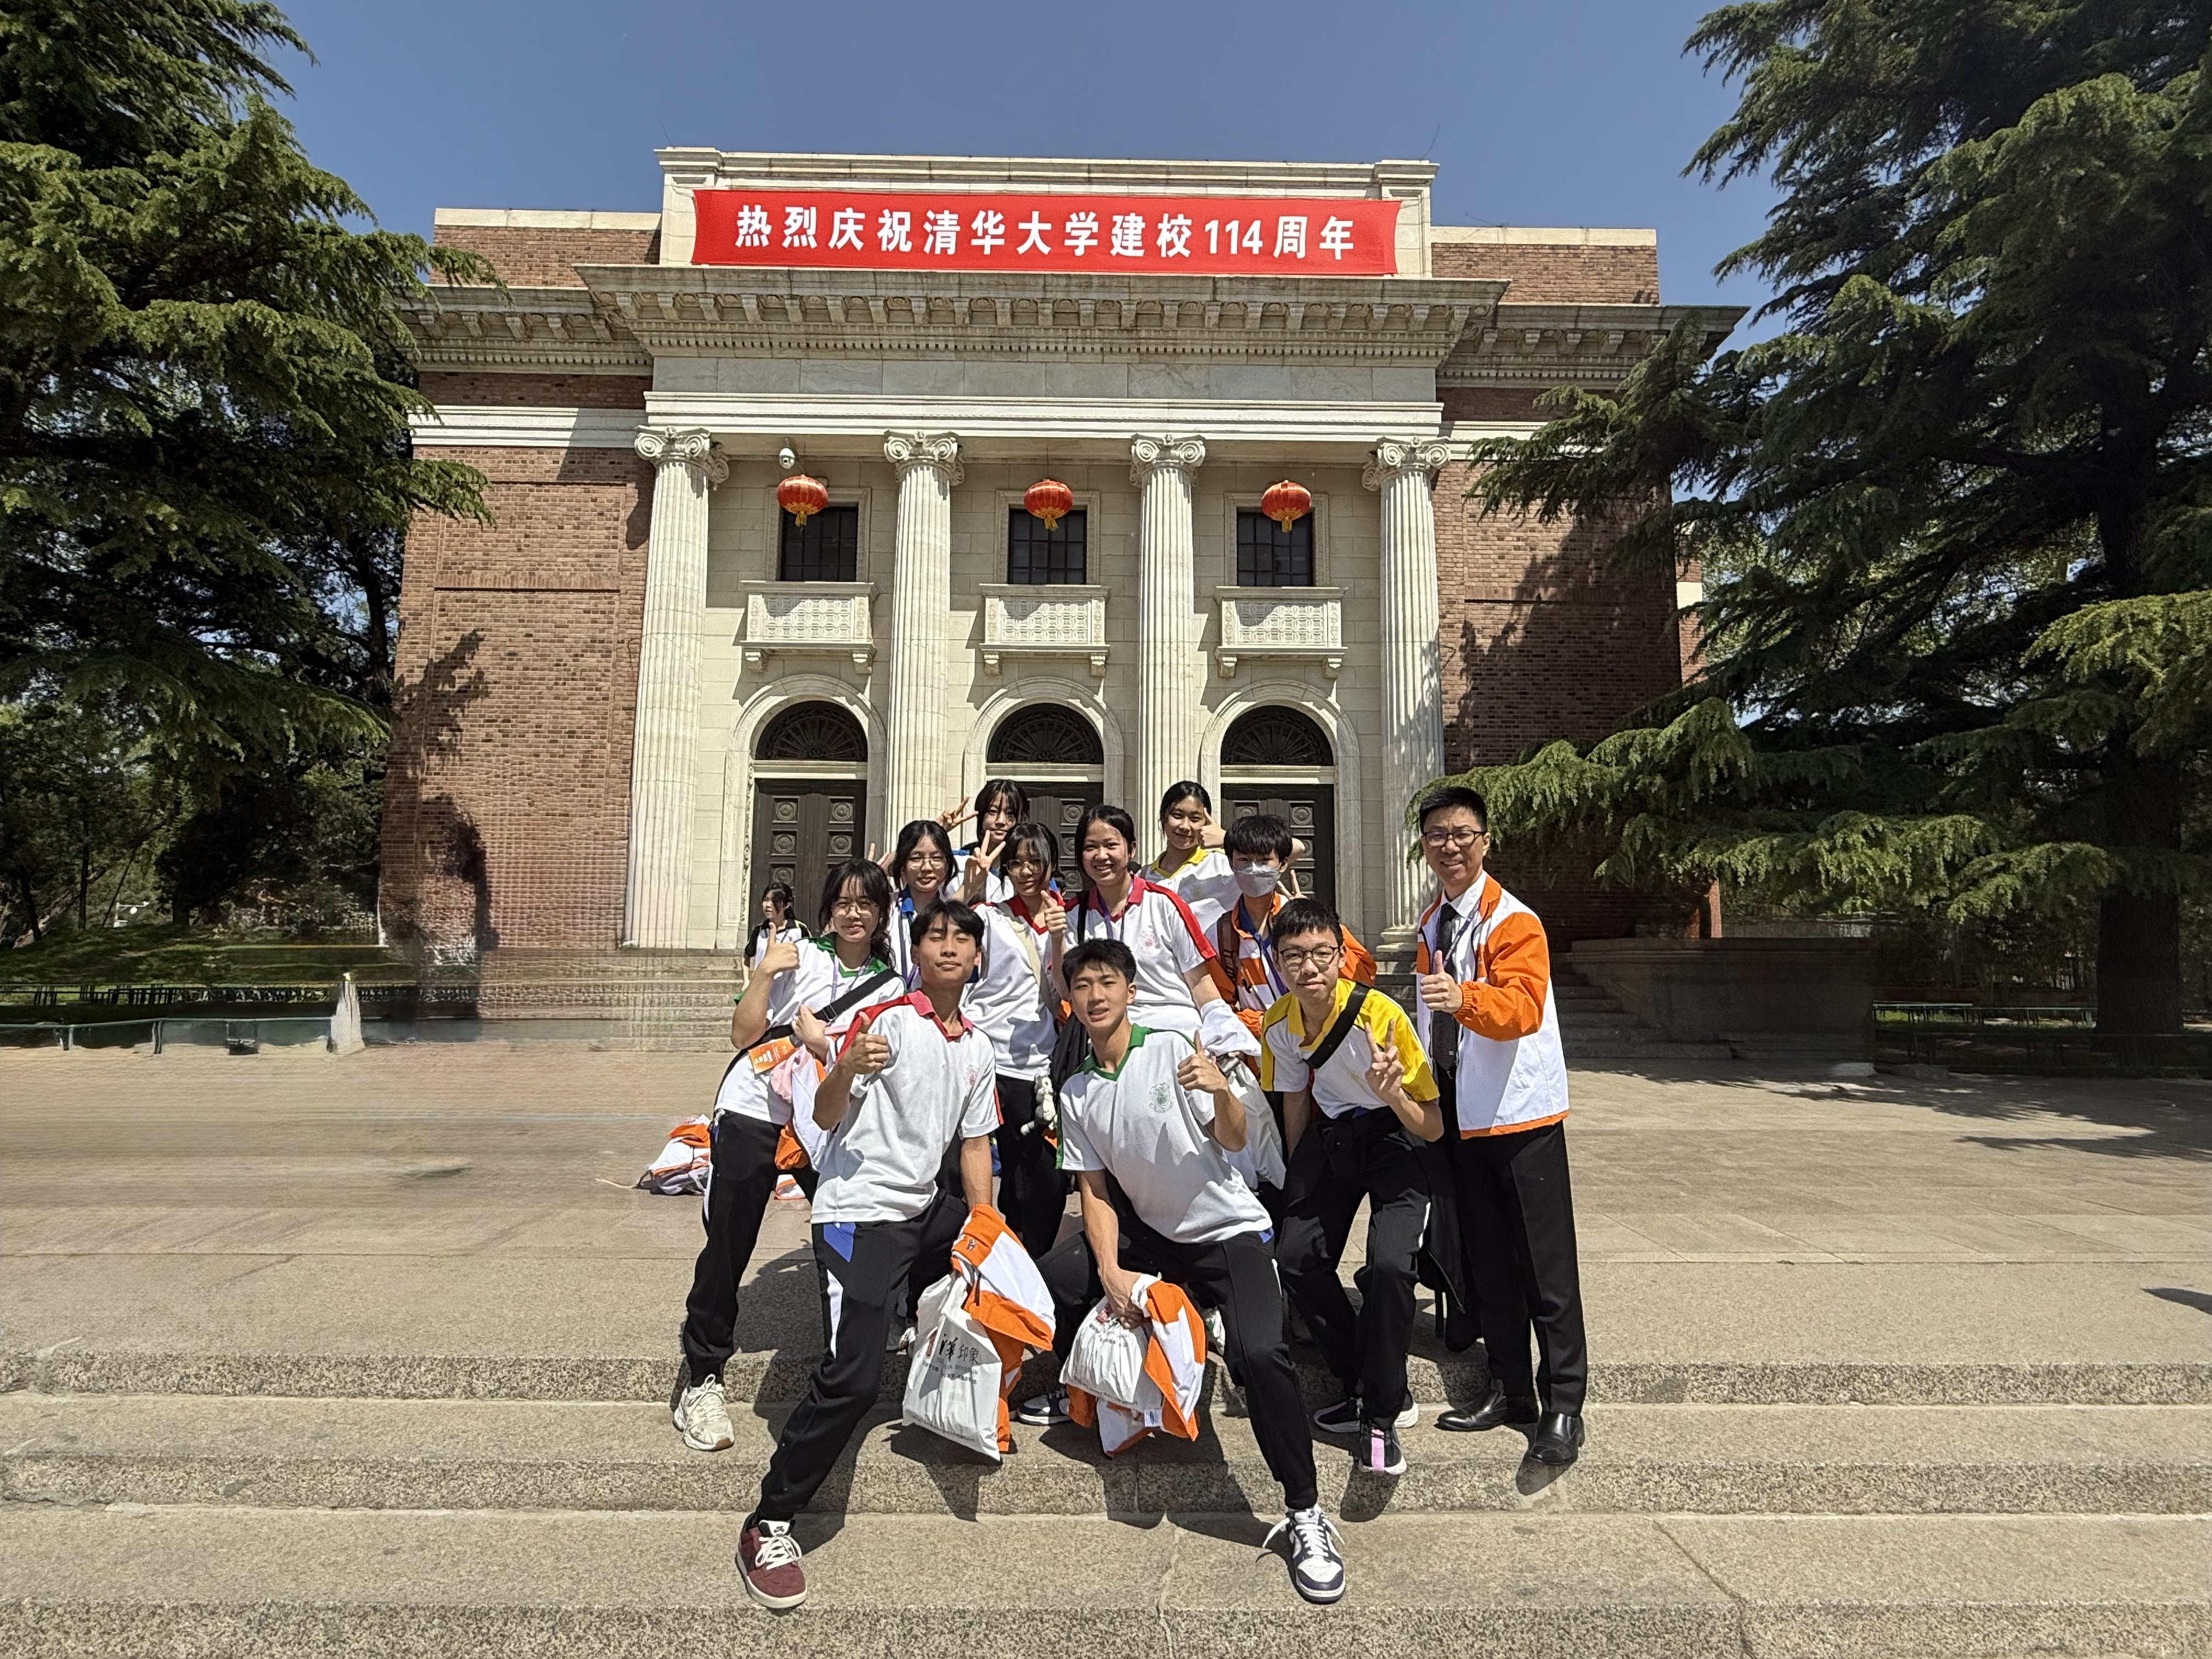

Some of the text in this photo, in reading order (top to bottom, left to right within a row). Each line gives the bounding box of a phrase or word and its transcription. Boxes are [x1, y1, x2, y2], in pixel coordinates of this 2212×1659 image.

[735, 204, 1355, 261] 热烈庆祝清华大学建校114周年
